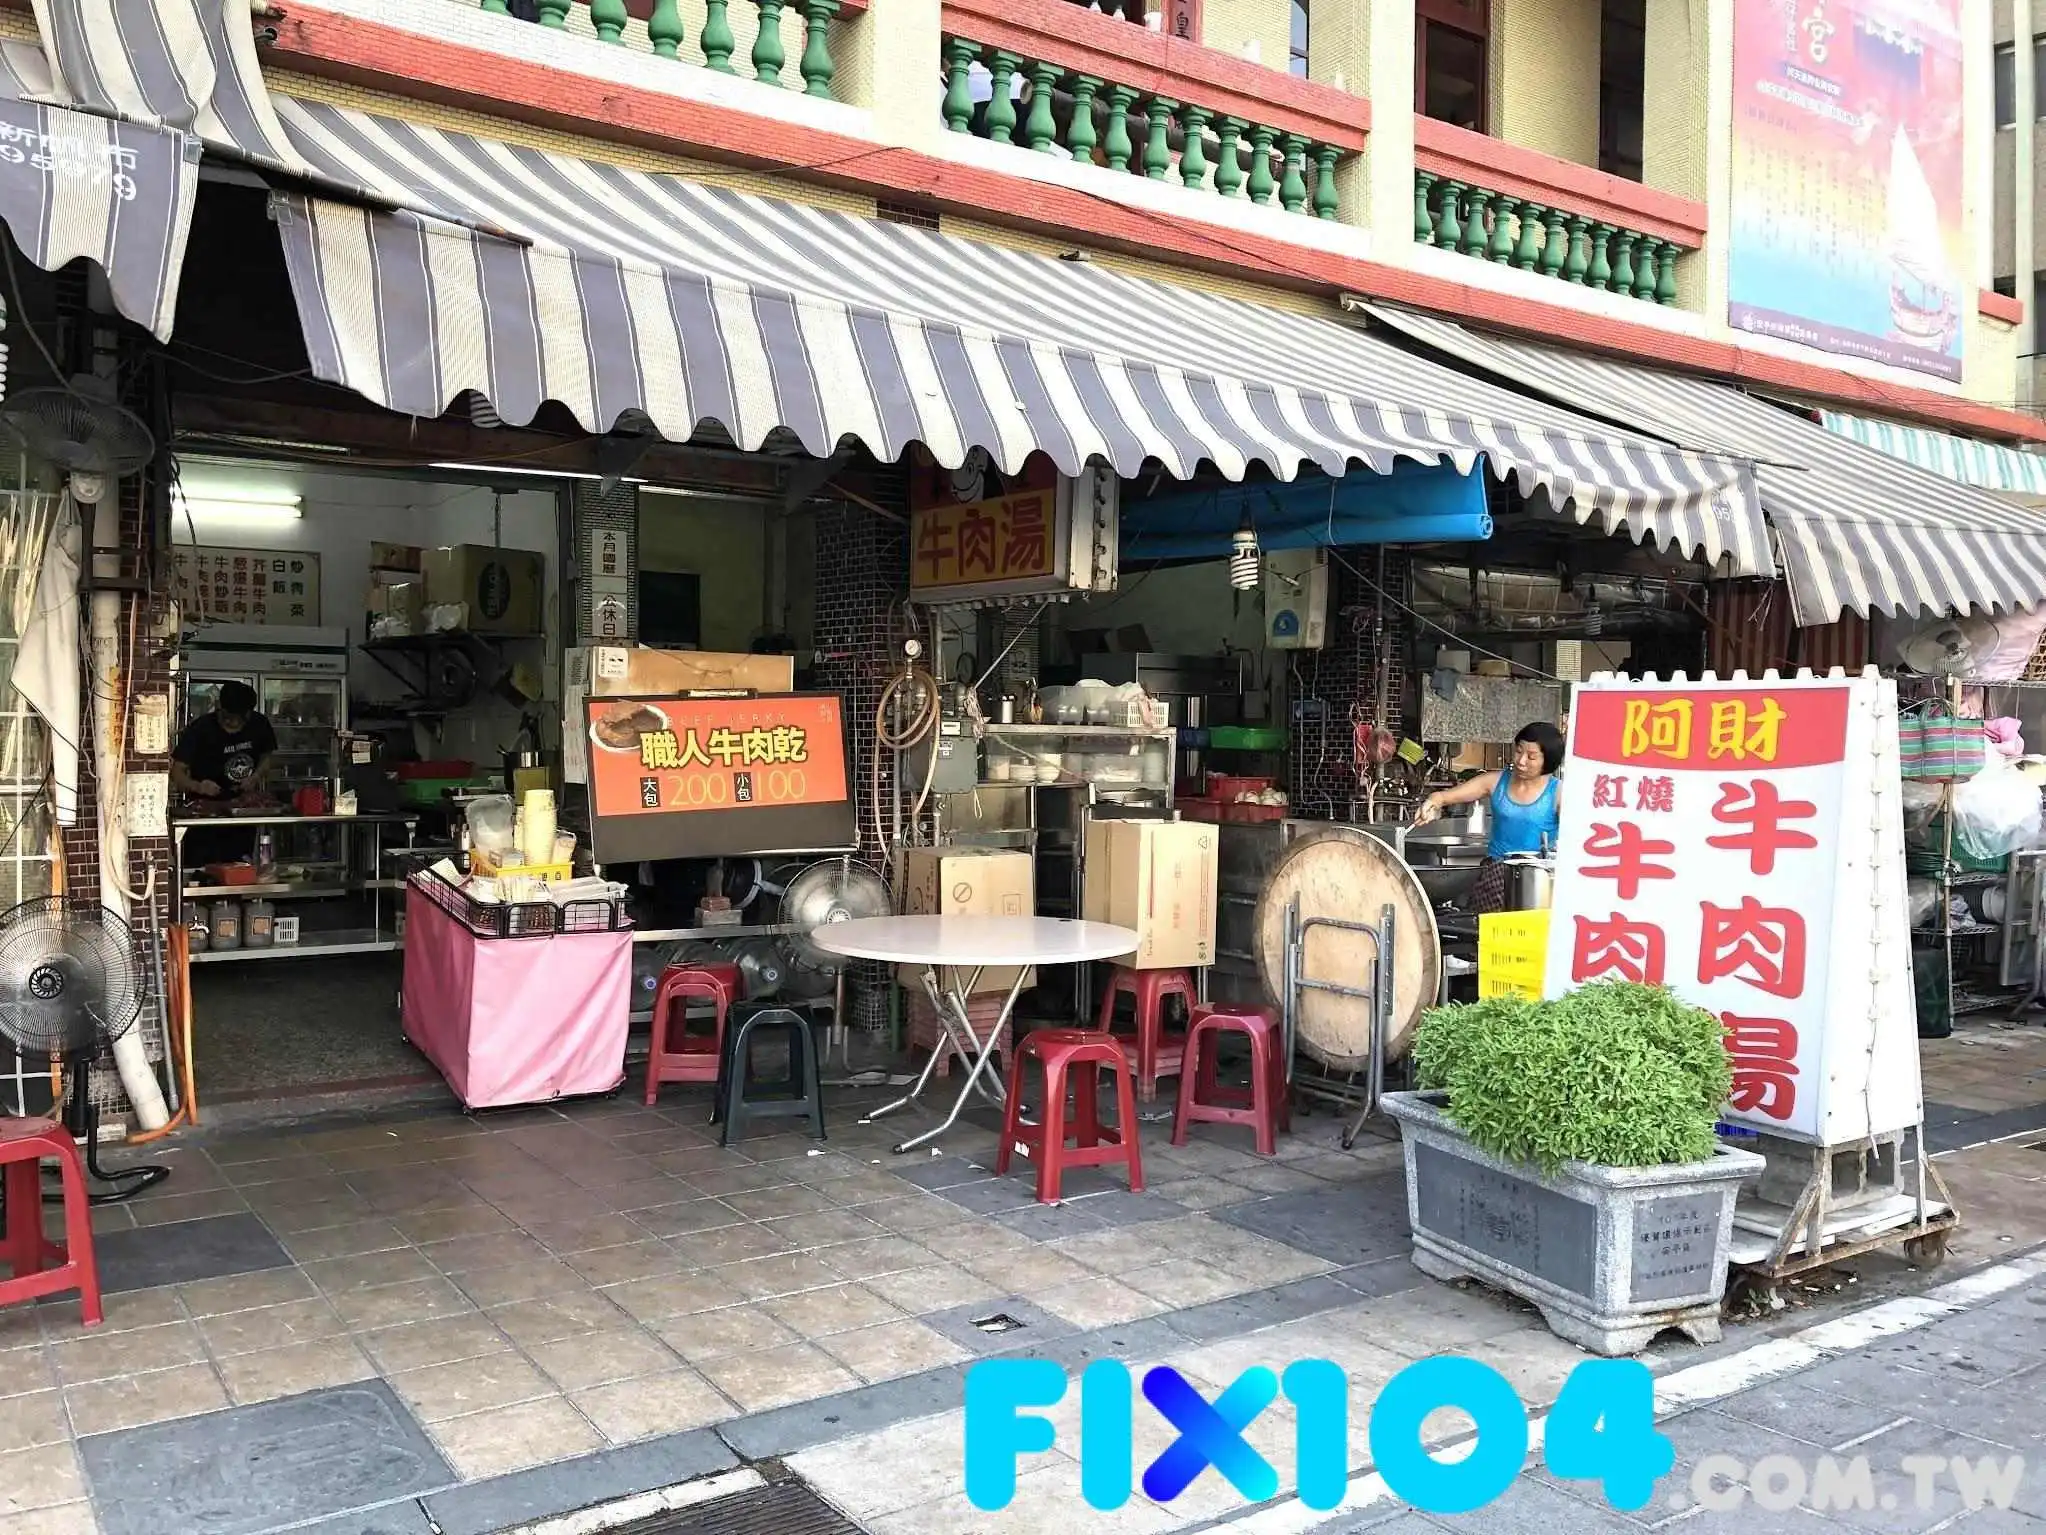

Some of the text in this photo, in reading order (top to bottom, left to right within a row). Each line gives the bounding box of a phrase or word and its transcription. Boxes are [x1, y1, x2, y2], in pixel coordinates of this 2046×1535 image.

[1175, 0, 1190, 39] 皇
[1801, 0, 1834, 63] 宮
[917, 496, 1047, 580] 牛肉湯
[272, 558, 286, 594] 白飯
[602, 594, 617, 636] 公休日
[639, 726, 808, 769] 職人牛肉乾
[1622, 696, 1789, 762] 阿財
[643, 769, 806, 807] 大包 200 小包 100
[1592, 774, 1676, 812] 紅燒
